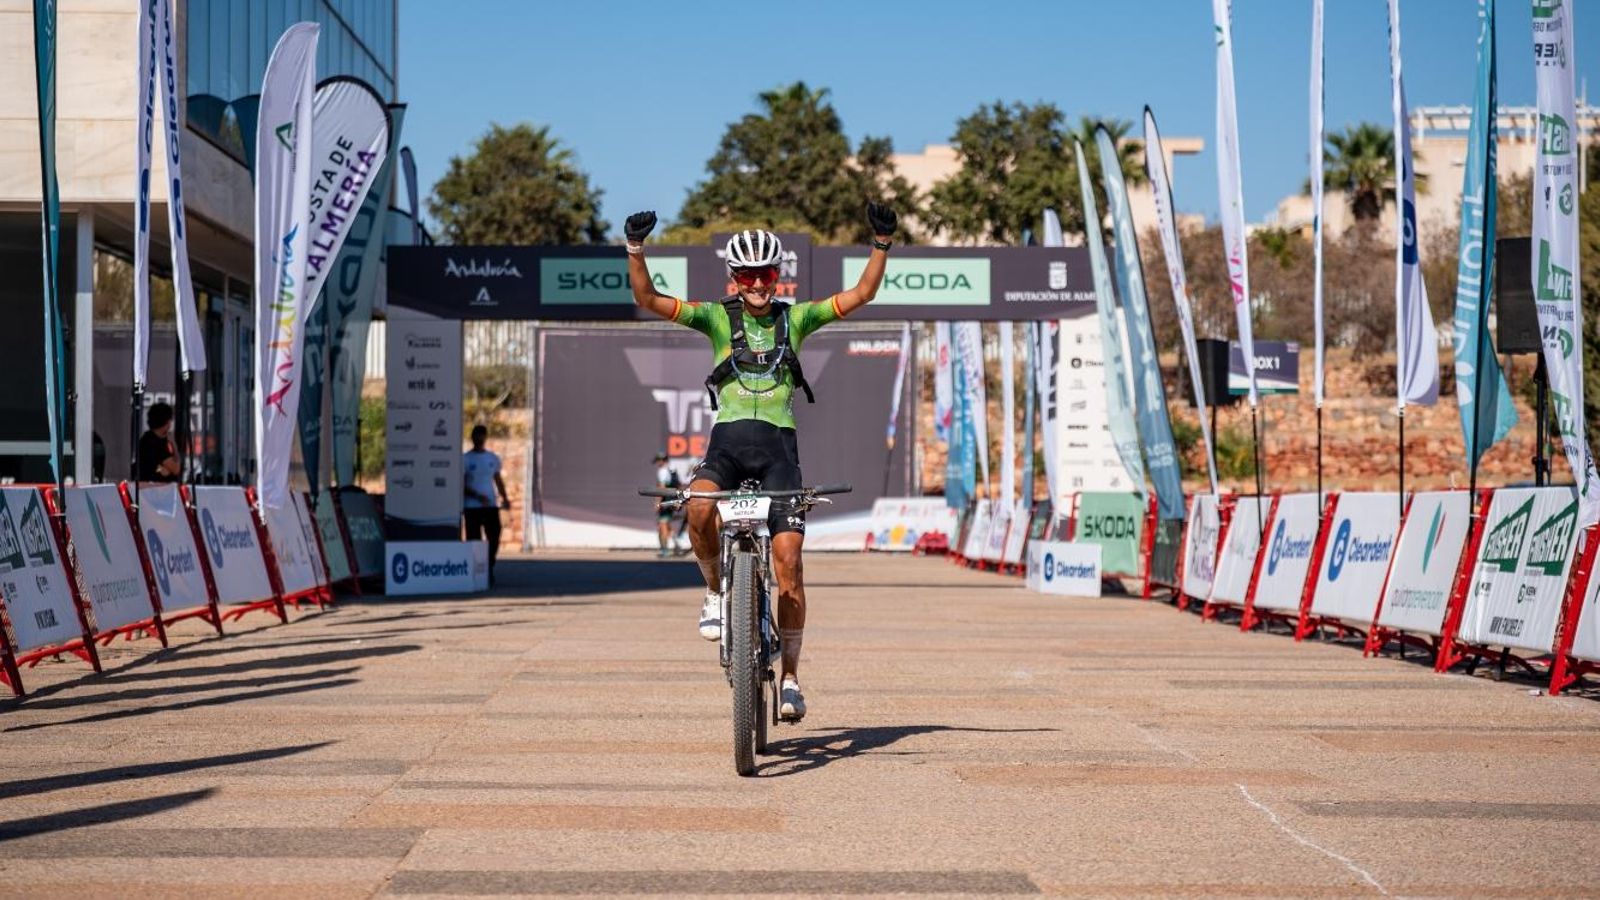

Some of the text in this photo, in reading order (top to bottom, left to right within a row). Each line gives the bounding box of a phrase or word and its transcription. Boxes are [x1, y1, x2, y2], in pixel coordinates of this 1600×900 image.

[329, 135, 354, 166] DE
[306, 150, 378, 273] ALMERÍA
[883, 273, 973, 290] KODA
[1275, 356, 1281, 369] 1
[730, 499, 758, 509] 202
[1348, 535, 1392, 563] Cleardent
[412, 559, 468, 577] Cleardent
[1057, 561, 1096, 578] Cleardent
